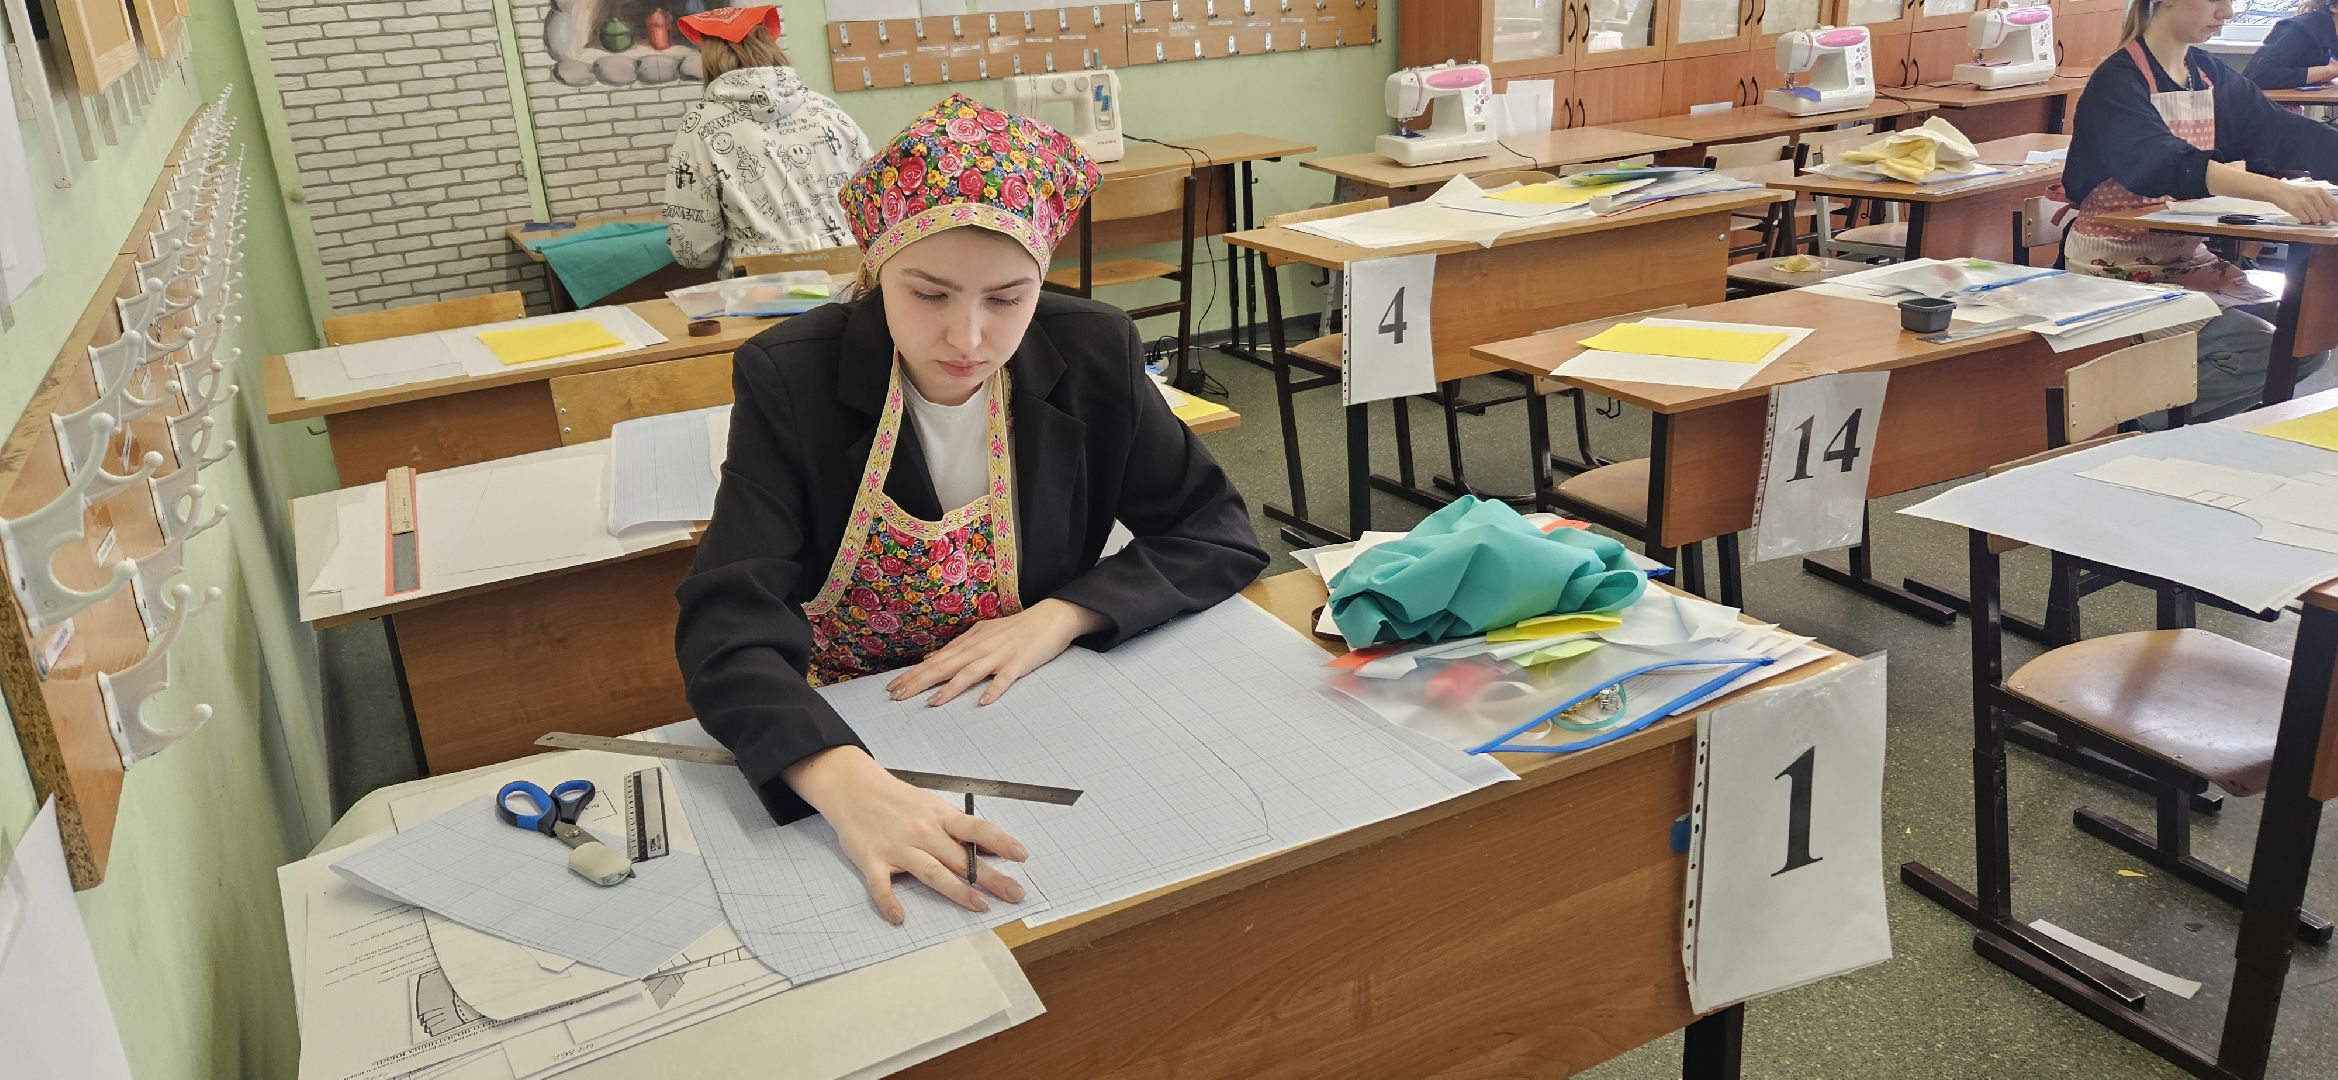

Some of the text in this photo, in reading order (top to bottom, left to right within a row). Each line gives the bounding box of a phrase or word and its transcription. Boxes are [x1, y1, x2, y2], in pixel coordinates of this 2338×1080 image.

[1378, 286, 1407, 344] 4
[1786, 408, 1863, 483] 14
[1770, 745, 1824, 878] 1
